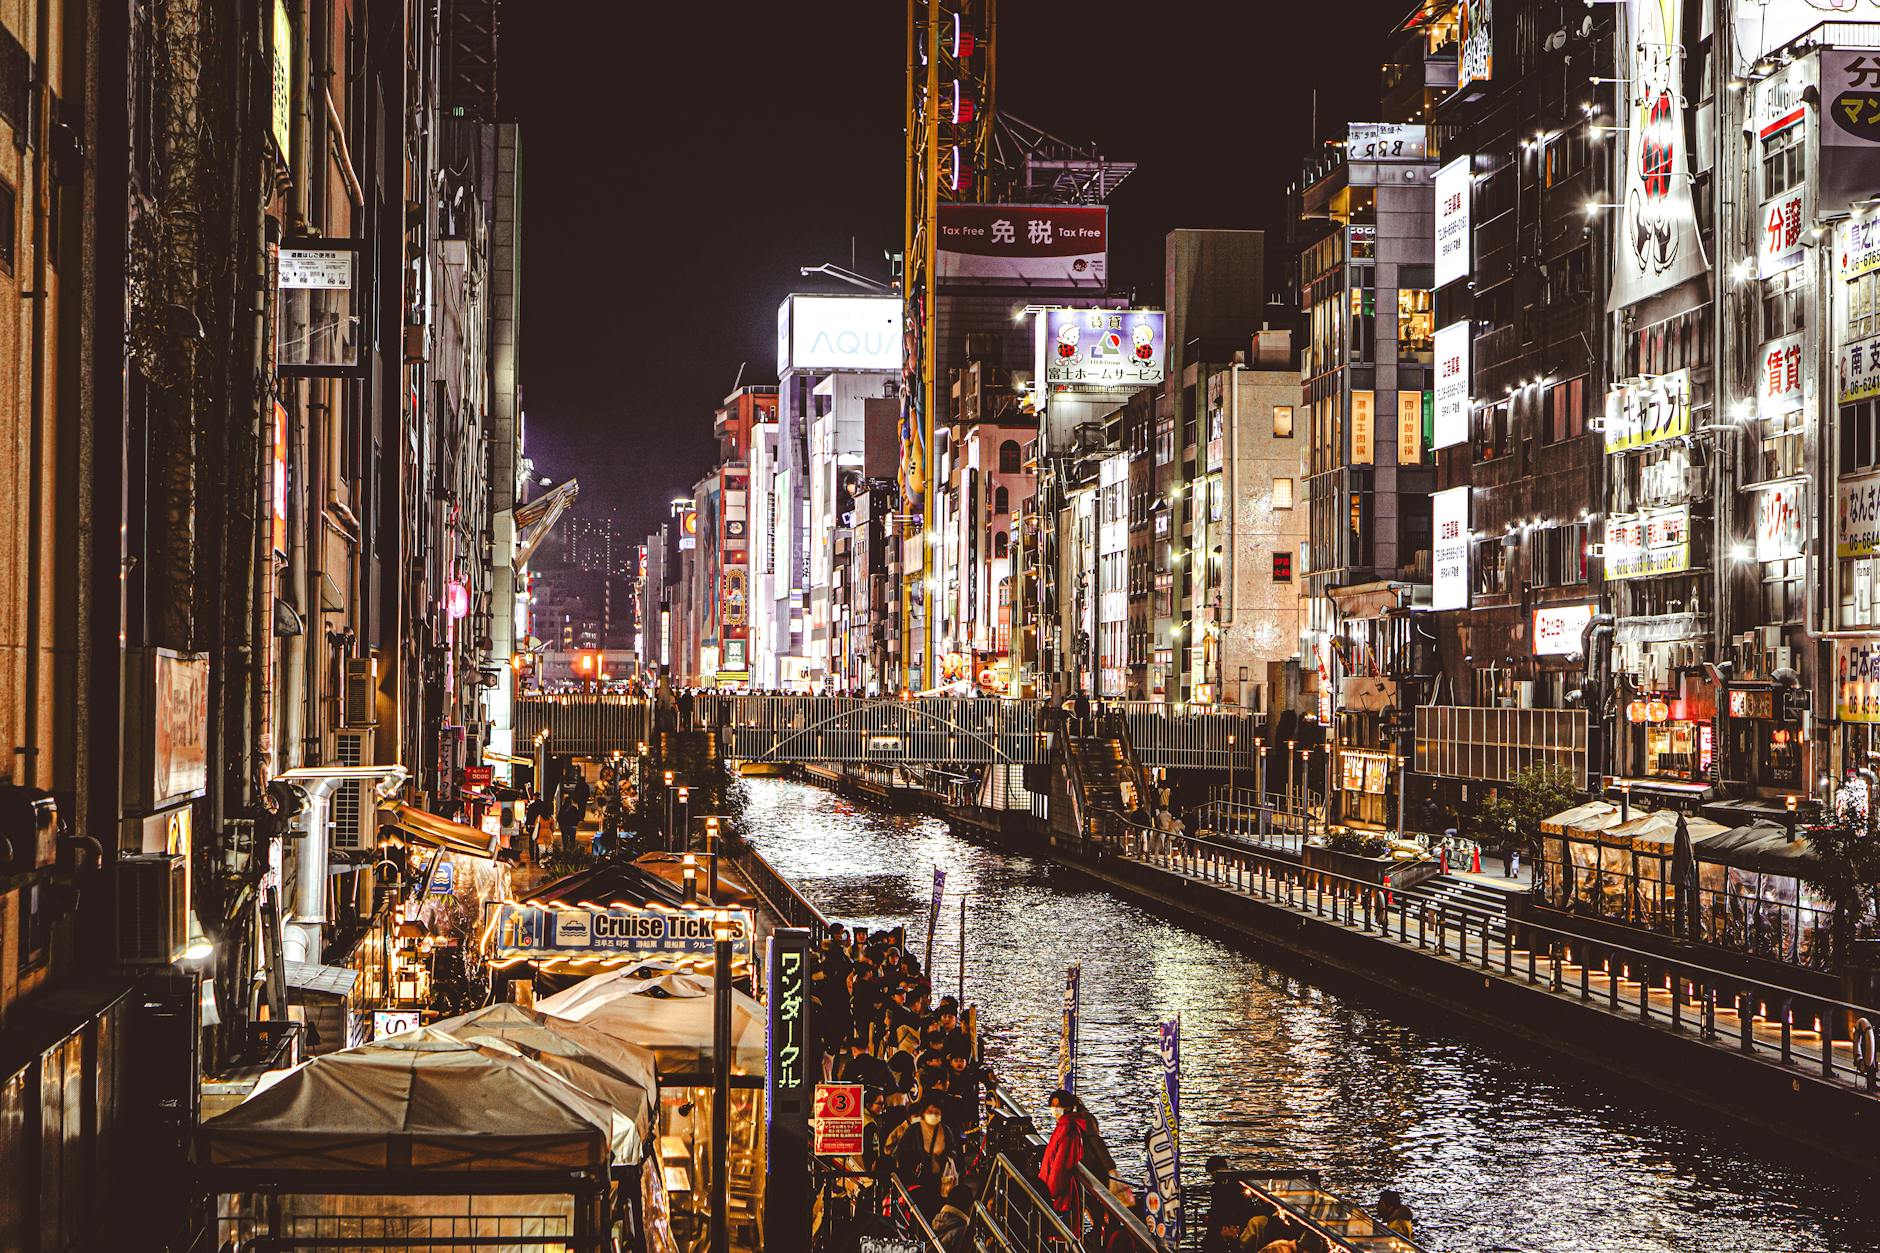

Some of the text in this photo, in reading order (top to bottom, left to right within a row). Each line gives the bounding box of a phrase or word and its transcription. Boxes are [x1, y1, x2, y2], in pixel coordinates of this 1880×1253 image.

[942, 219, 1101, 245] Tax Free 免税 Tax Free
[1768, 197, 1802, 254] 分譲
[1048, 367, 1162, 381] 富士ホームサービス
[1767, 343, 1801, 398] 賃貸
[595, 914, 745, 939] Cruise Ticks
[779, 952, 802, 1088] ワンダークル
[836, 1095, 847, 1110] 3
